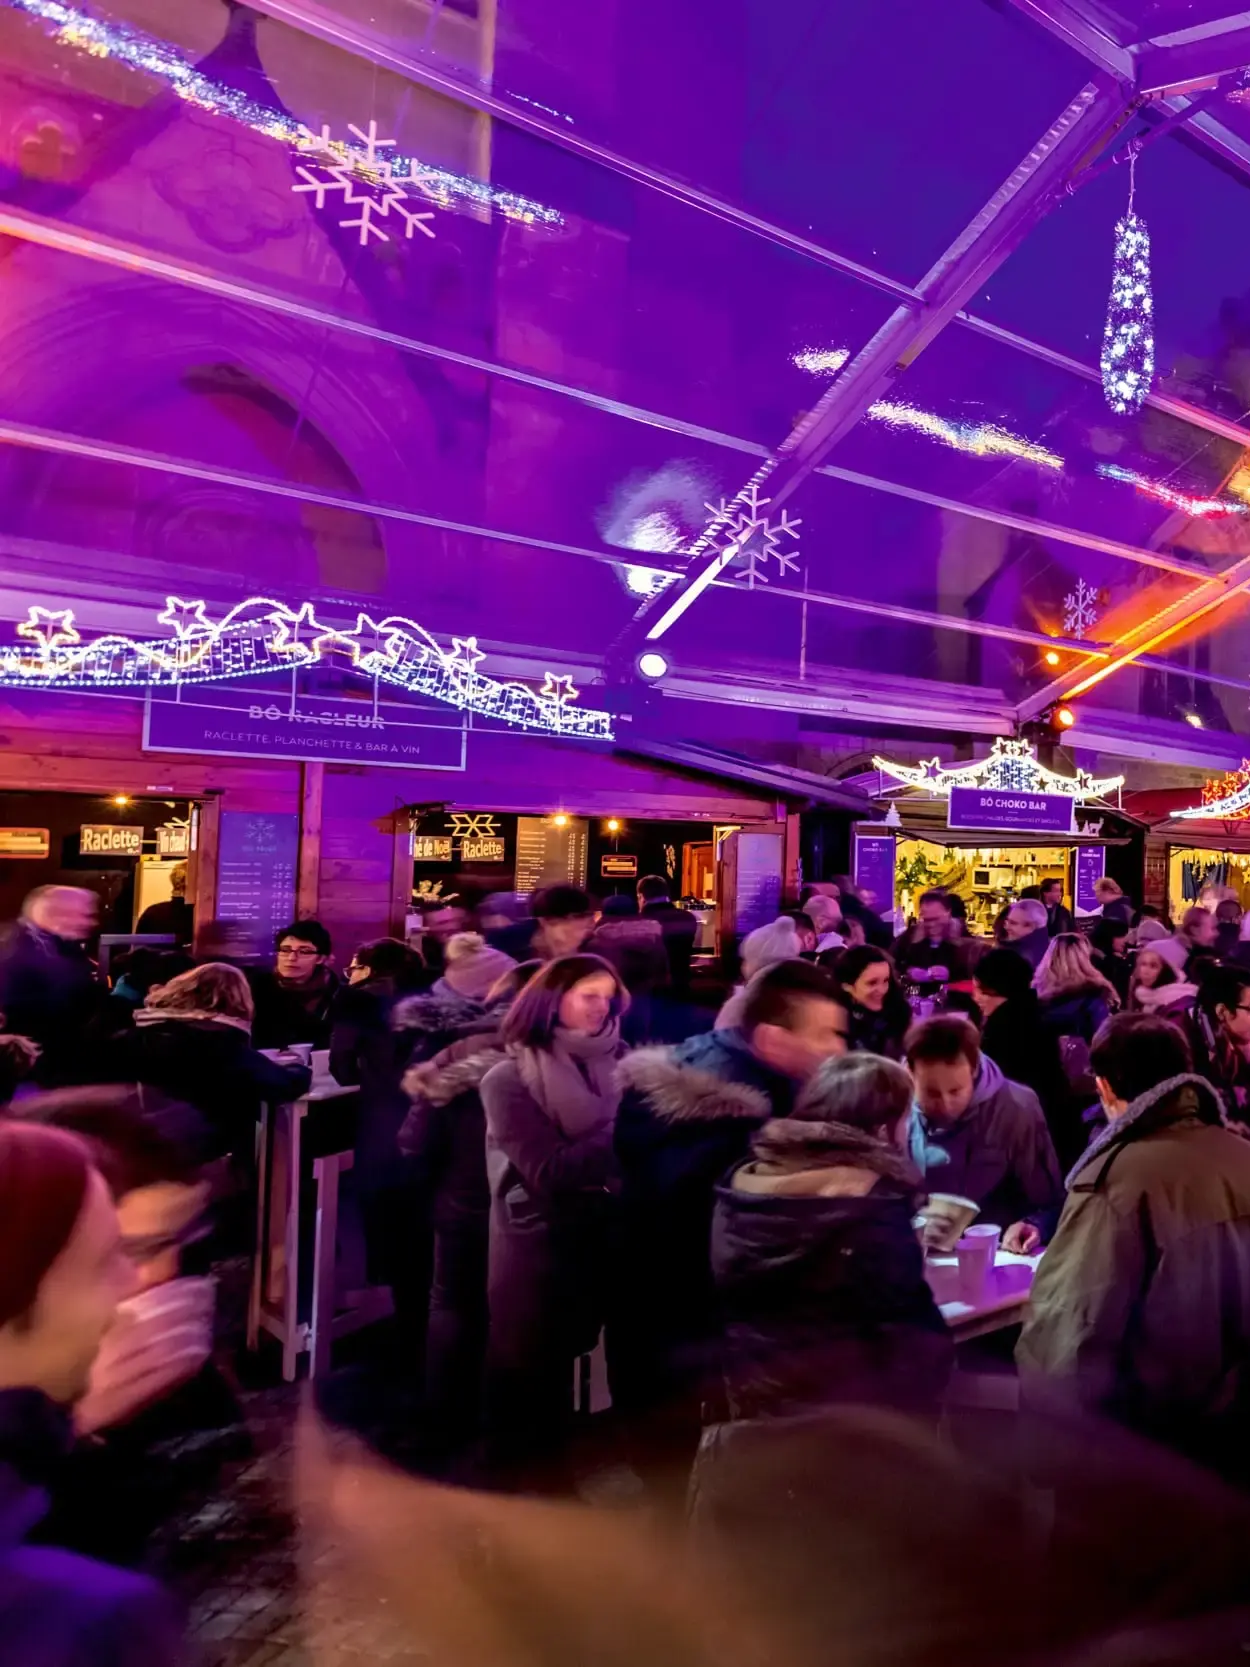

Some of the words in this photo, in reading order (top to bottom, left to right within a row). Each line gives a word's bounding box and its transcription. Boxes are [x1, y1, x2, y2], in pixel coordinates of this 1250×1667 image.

[249, 704, 281, 721] BÔ
[288, 708, 385, 730] RACLEUR
[275, 735, 353, 750] PLANCHETTE
[355, 741, 363, 751] &
[365, 742, 388, 753] BAR
[401, 744, 420, 755] VIN
[980, 796, 994, 807] BÔ
[995, 799, 1028, 809] CHOKO
[1029, 801, 1047, 811] BAR
[83, 828, 140, 851] Raclette
[463, 839, 502, 859] Raclette
